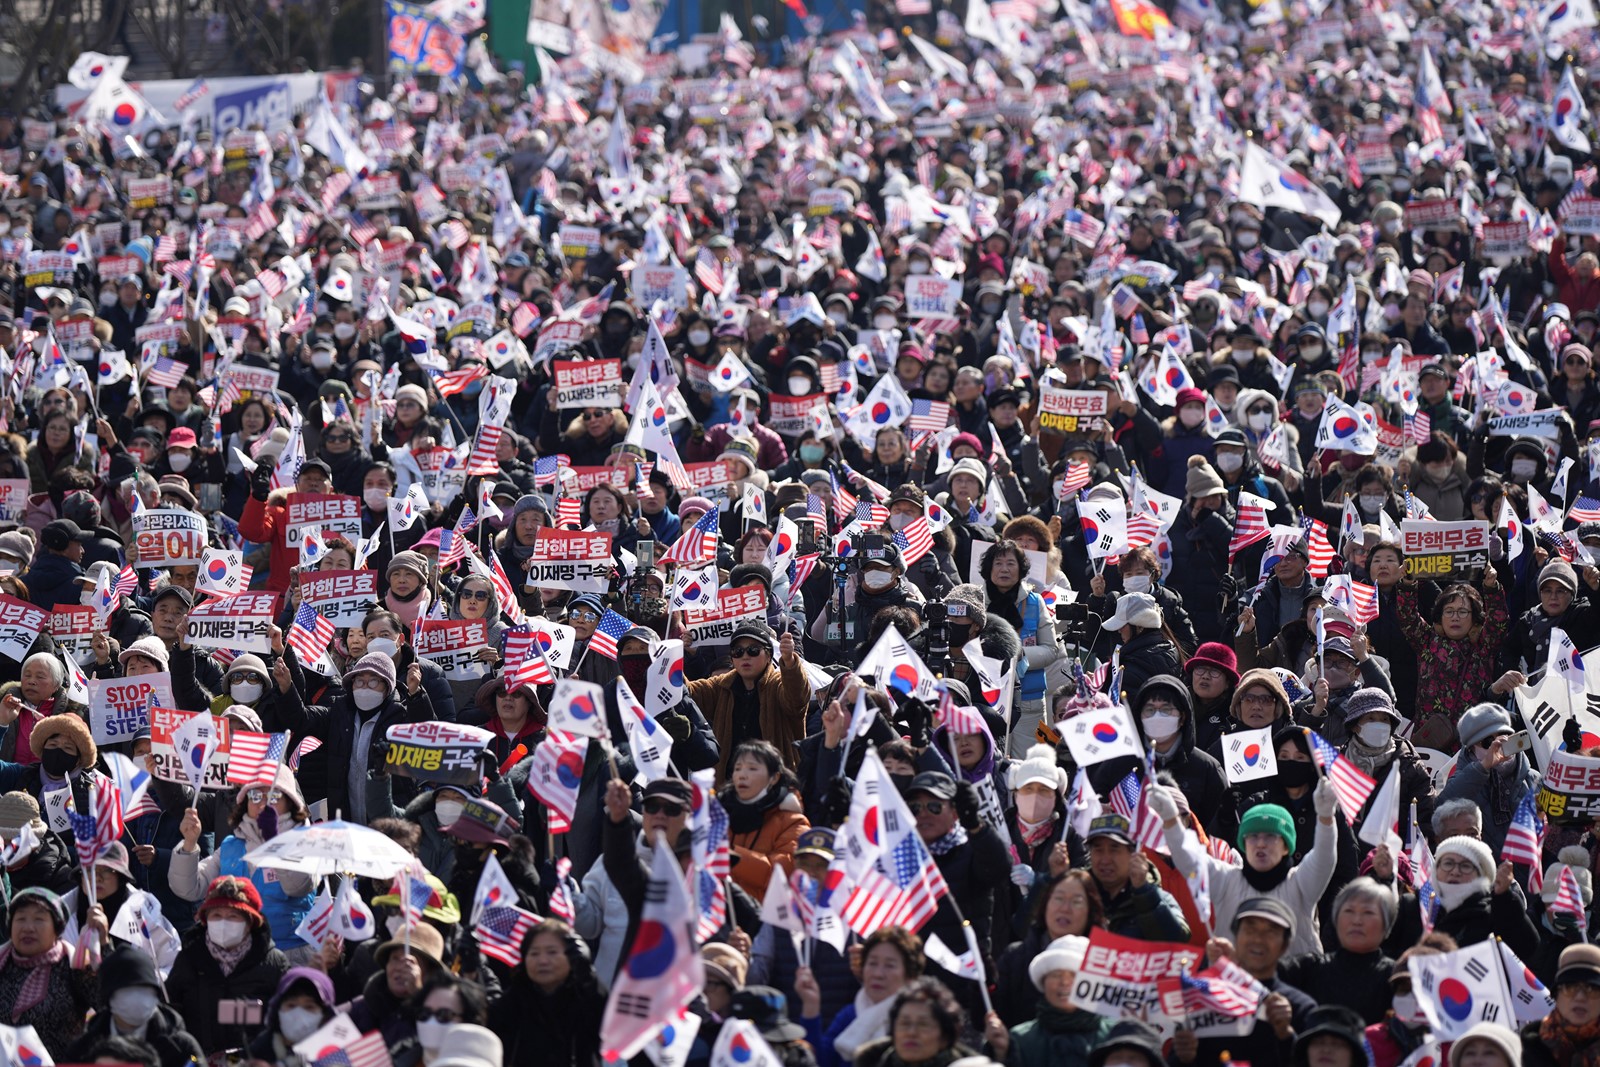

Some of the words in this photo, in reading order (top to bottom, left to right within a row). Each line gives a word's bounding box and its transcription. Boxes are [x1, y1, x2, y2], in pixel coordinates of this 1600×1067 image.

[557, 362, 620, 386] 탄핵무효
[558, 387, 595, 403] 이재명
[1042, 393, 1104, 413] 탄핵무효
[1040, 414, 1077, 432] 이재명
[1490, 415, 1528, 430] 이재명
[564, 469, 626, 493] 탄핵무효
[289, 499, 358, 523] 탄핵무효
[533, 536, 608, 560] 탄핵무효
[1405, 526, 1484, 552] 탄핵무효
[530, 564, 576, 582] 이재명
[577, 564, 608, 580] 구속
[1406, 555, 1452, 575] 이재명
[1453, 553, 1486, 571] 구속
[301, 573, 374, 602] 탄핵무효
[188, 621, 235, 639] 이재명
[238, 621, 270, 639] 구속
[690, 622, 734, 642] 이재명
[106, 683, 151, 703] STOP
[114, 700, 147, 718] THE
[105, 717, 149, 736] STEA
[386, 743, 443, 771] 이재명
[442, 749, 478, 771] 구속
[1547, 761, 1600, 790] 핵무효
[1085, 944, 1199, 981] 탄핵무효
[1076, 980, 1149, 1011] 이재명
